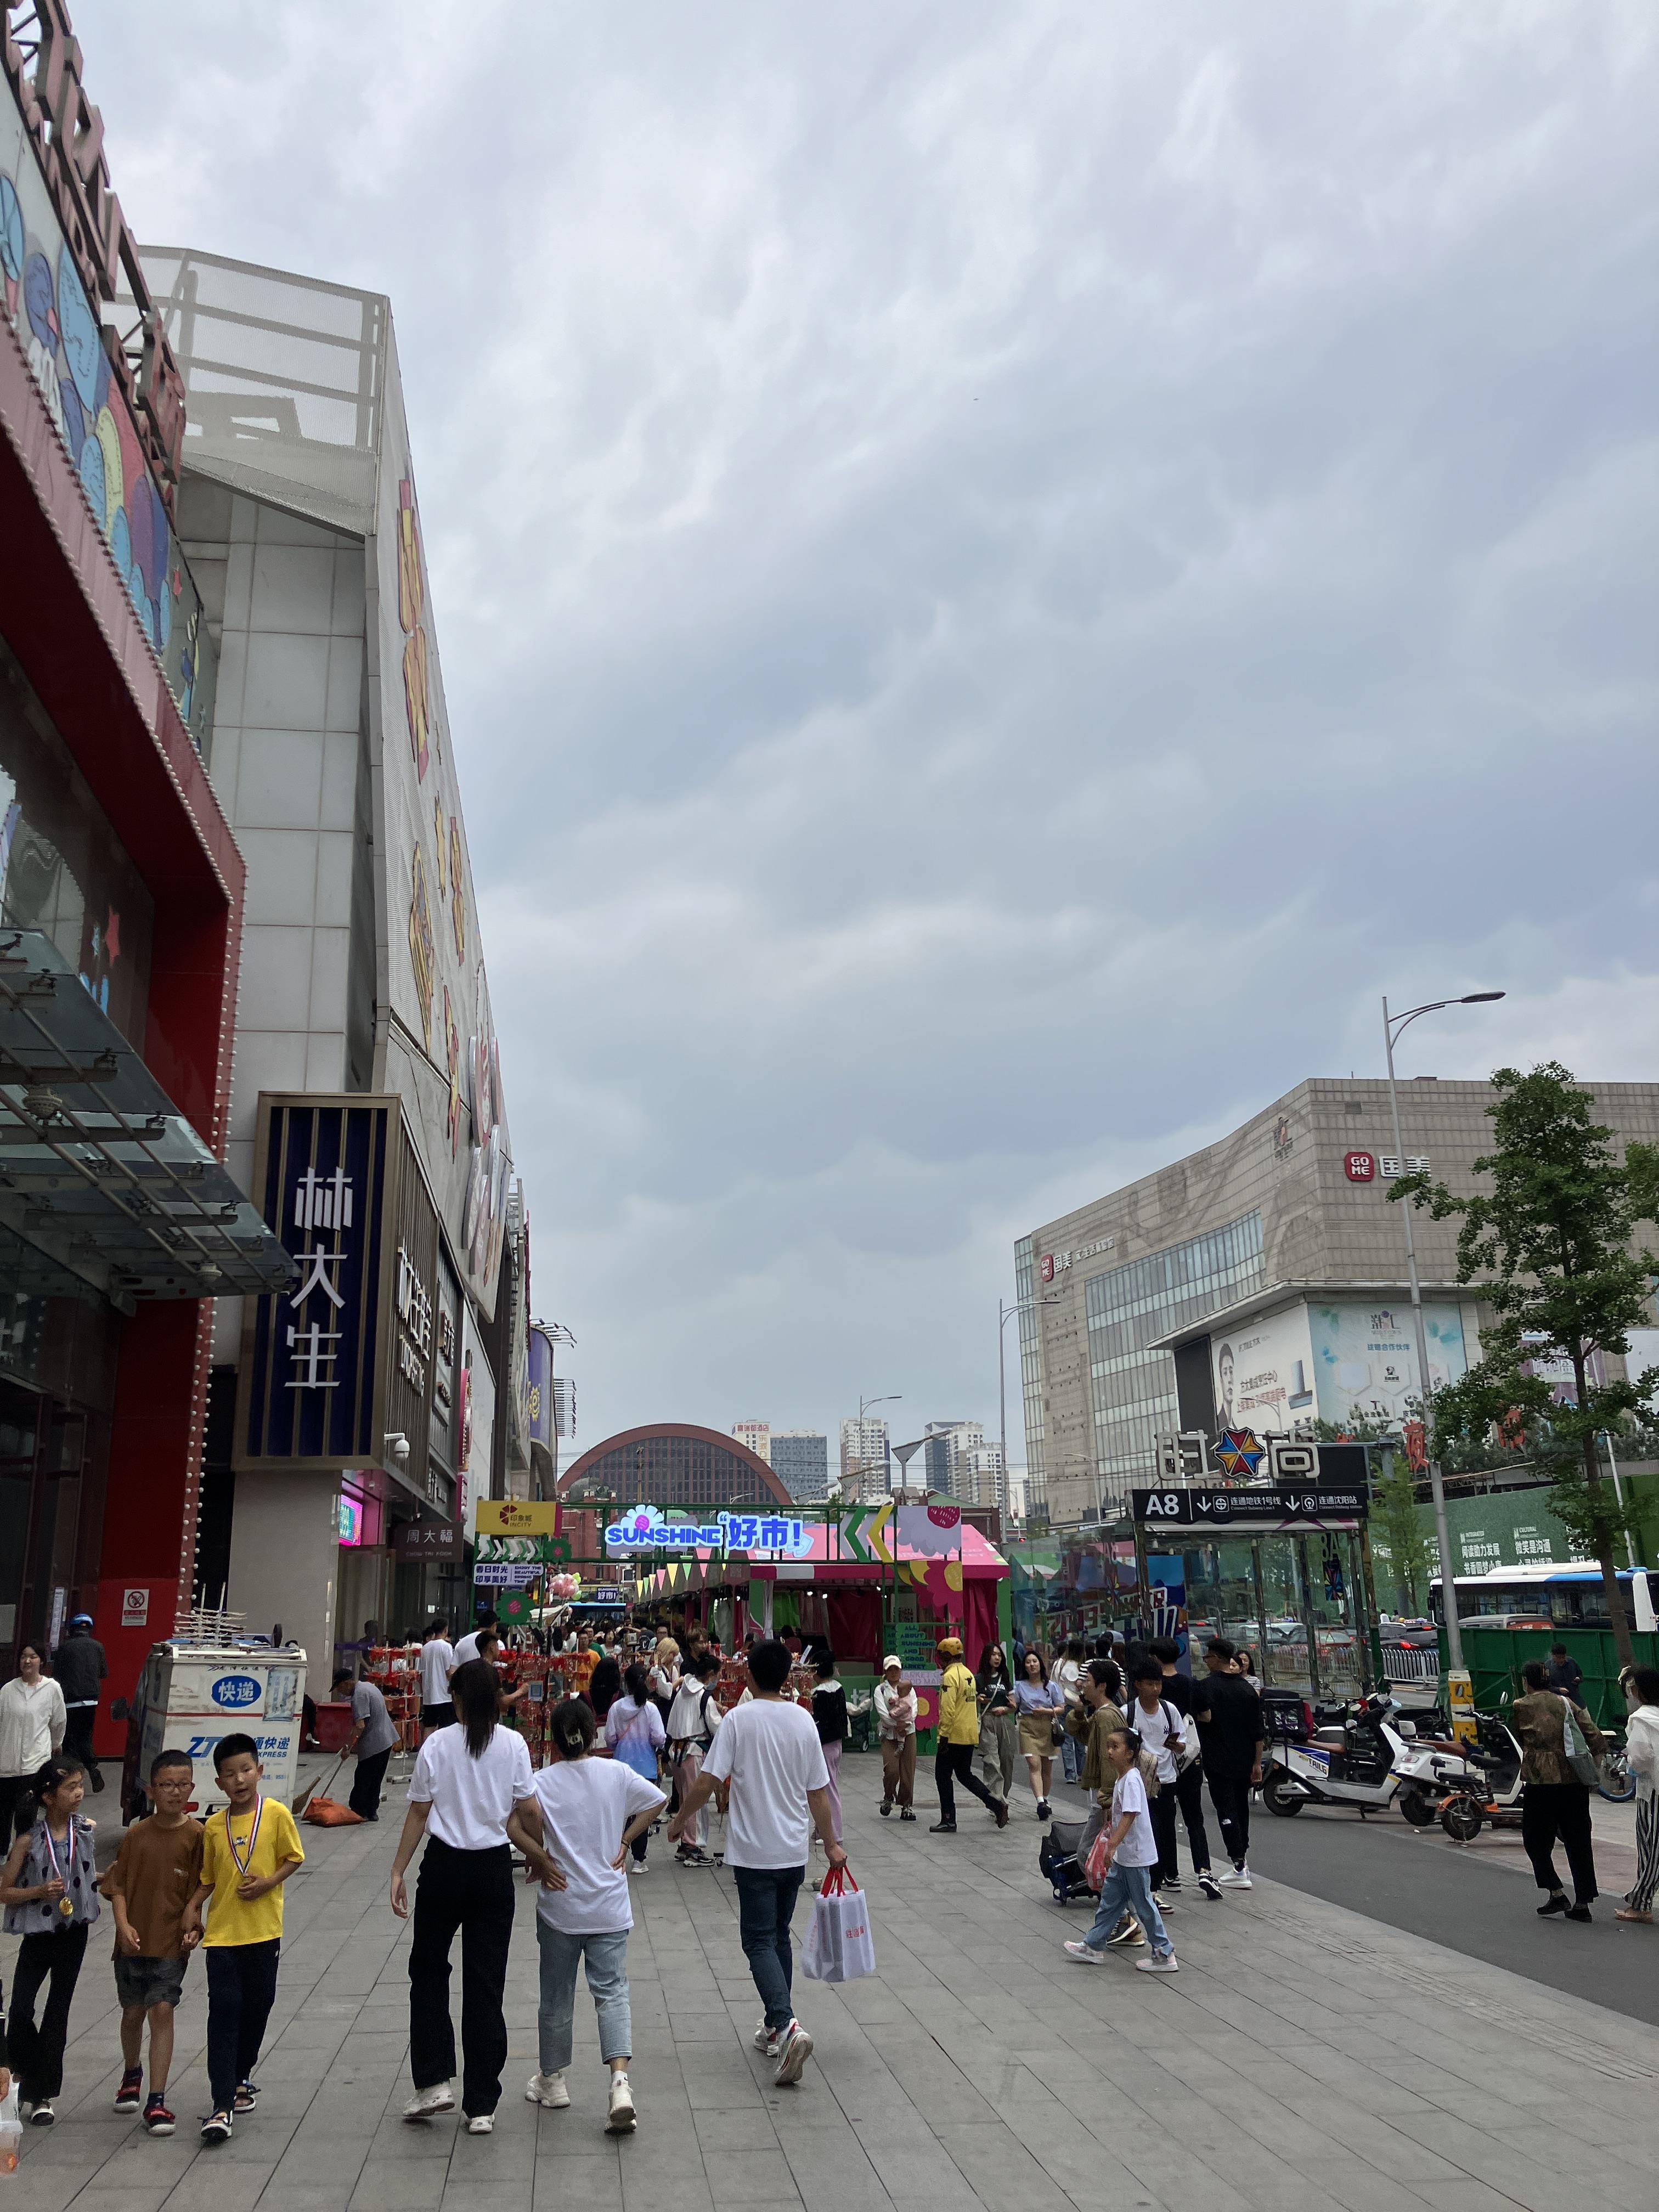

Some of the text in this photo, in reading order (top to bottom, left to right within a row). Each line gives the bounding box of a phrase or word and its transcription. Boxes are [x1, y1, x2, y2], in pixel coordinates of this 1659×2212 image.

[1350, 1156, 1369, 1166] GO
[1379, 1155, 1432, 1178] 国美
[1351, 1166, 1370, 1175] ME
[284, 1166, 353, 1389] 林大生
[1146, 1494, 1179, 1515] A8
[1231, 1496, 1282, 1505] 连通地铁1号线
[1319, 1496, 1357, 1504] 连通沈阳站
[406, 1529, 453, 1543] 周大福
[607, 1527, 721, 1544] SUNSHINE
[1461, 1543, 1501, 1559] 阅读助力发展
[1515, 1538, 1551, 1555] 微笑是沟通
[476, 1565, 509, 1573] 春日时光
[218, 1681, 254, 1702] 快递
[187, 1736, 224, 1758] ZT
[1308, 1758, 1328, 1775] TAILG
